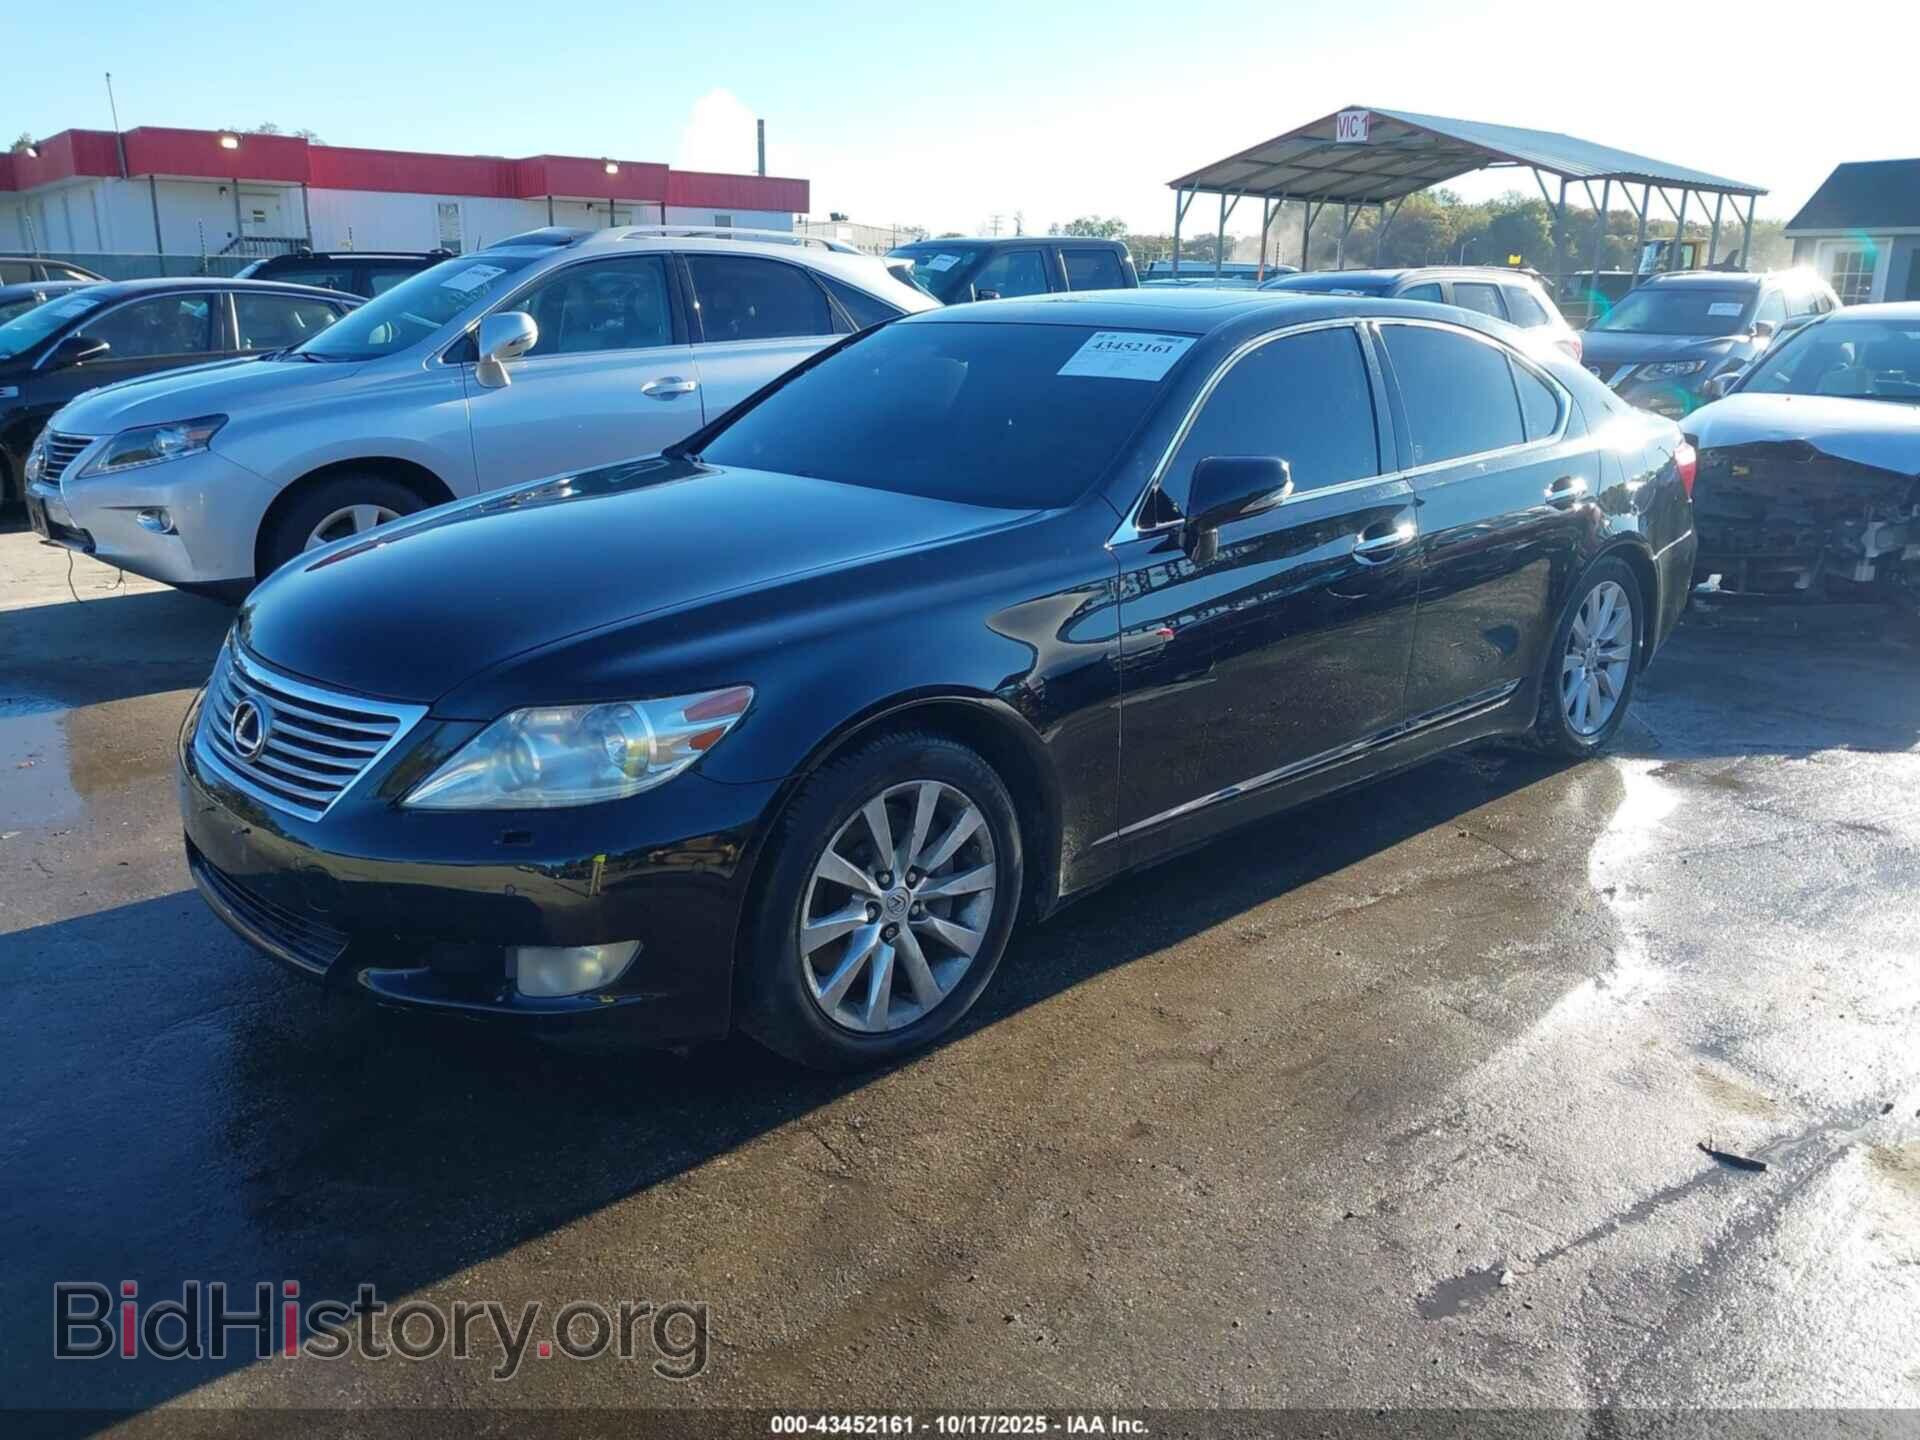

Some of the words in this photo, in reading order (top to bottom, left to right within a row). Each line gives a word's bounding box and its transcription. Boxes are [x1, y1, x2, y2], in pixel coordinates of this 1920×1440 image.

[1338, 115, 1359, 137] VIC
[1362, 115, 1369, 137] 1
[1093, 341, 1173, 353] 43452161
